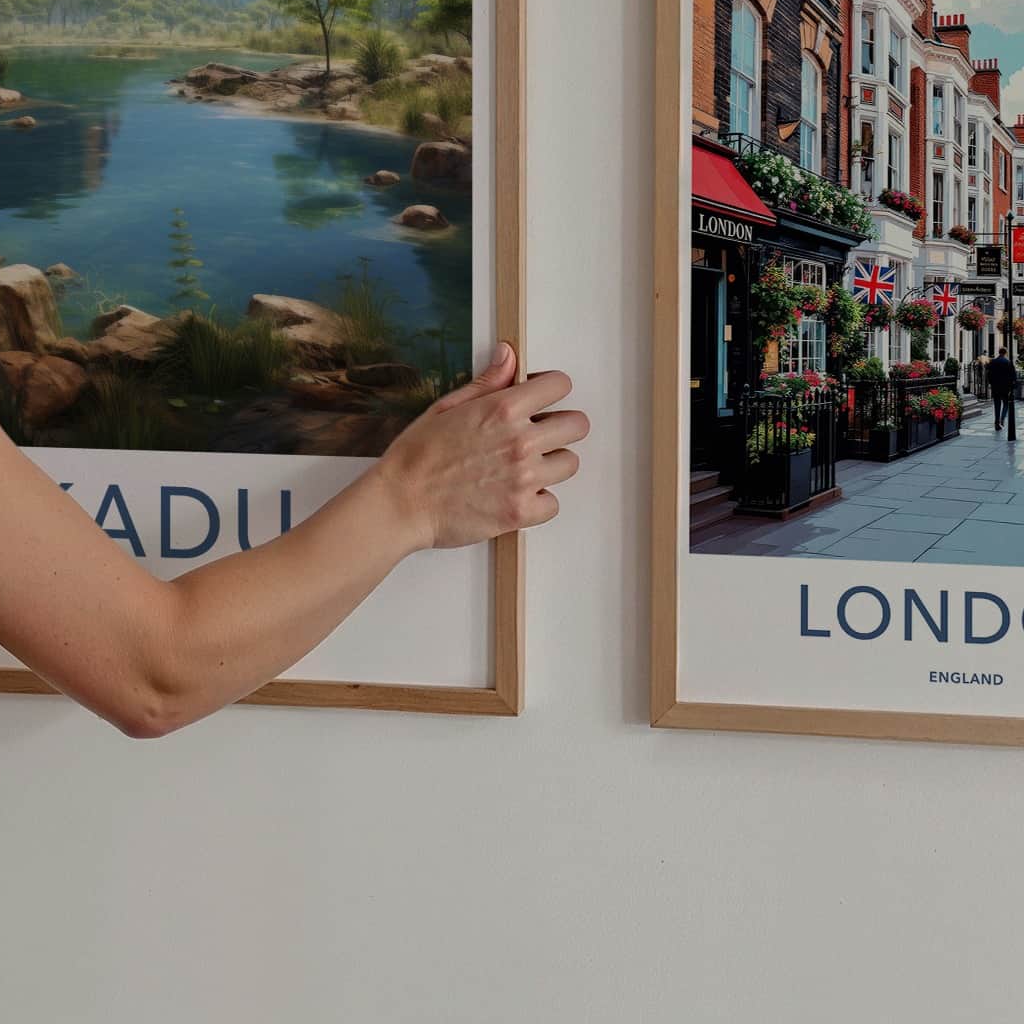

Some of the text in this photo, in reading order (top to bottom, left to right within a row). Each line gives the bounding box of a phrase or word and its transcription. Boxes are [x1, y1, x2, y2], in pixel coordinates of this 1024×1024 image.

[697, 212, 753, 242] LONDON
[59, 482, 292, 559] ADU
[800, 584, 1024, 645] LOND
[928, 670, 1005, 686] ENGLAND
